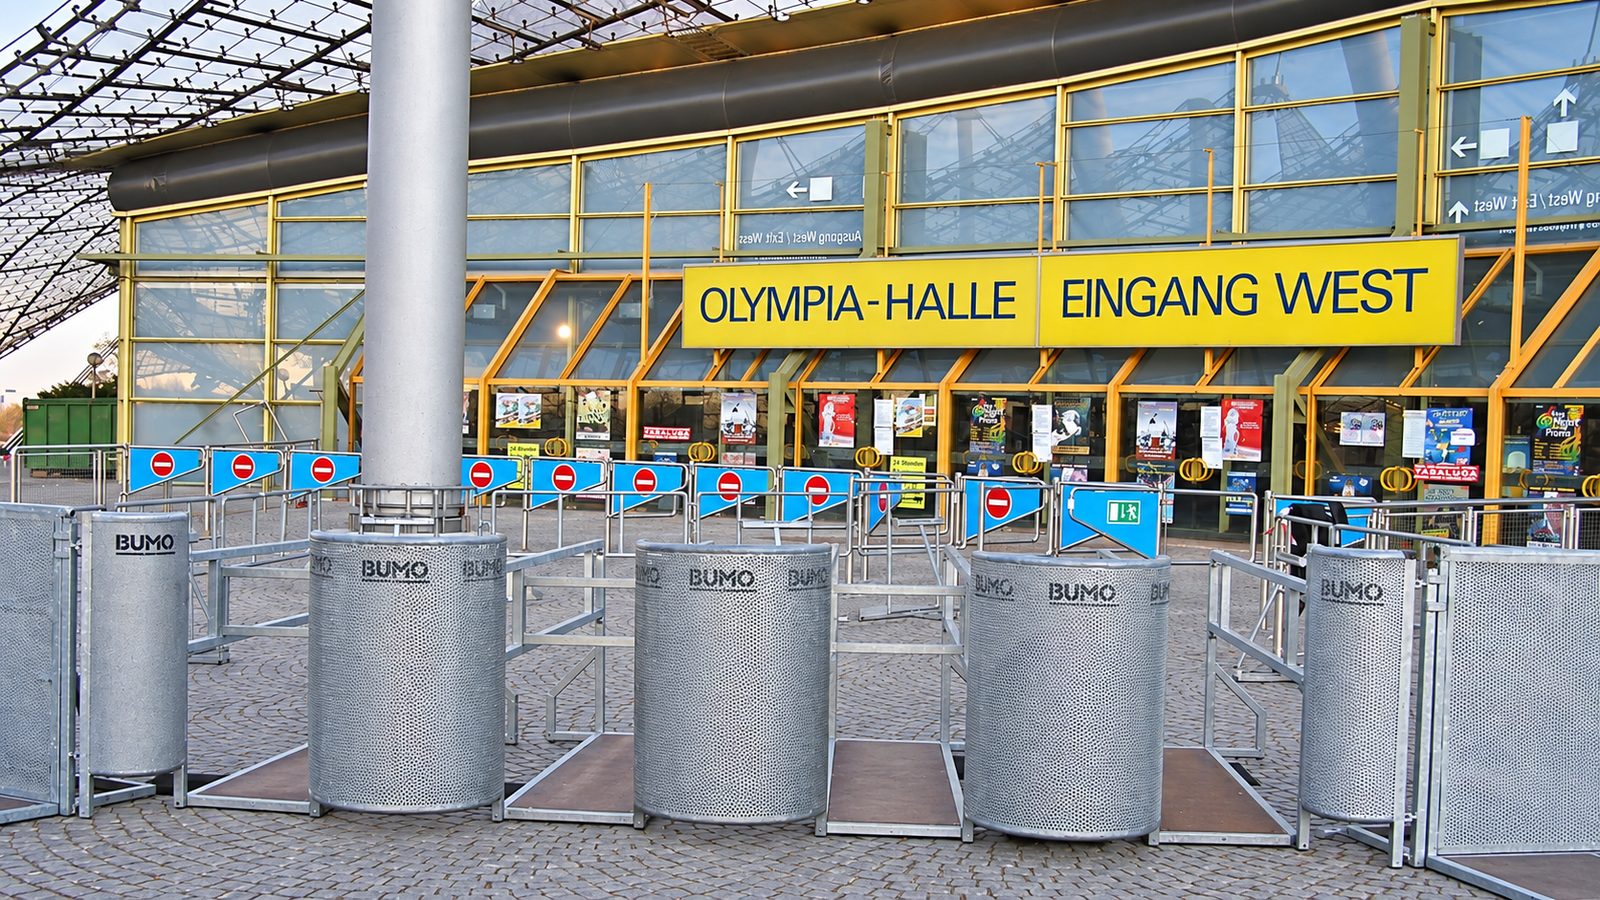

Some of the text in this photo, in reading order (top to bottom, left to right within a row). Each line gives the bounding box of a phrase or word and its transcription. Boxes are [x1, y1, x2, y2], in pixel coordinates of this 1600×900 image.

[700, 267, 1429, 324] OLYMPIA-HALLE EINGANG WEST
[116, 533, 174, 550] BUMO
[361, 559, 429, 579] BUMO
[689, 568, 755, 587] BUMO
[975, 574, 1014, 596] BUMO
[1049, 581, 1115, 602] BUMO
[1320, 578, 1384, 601] BUMO
